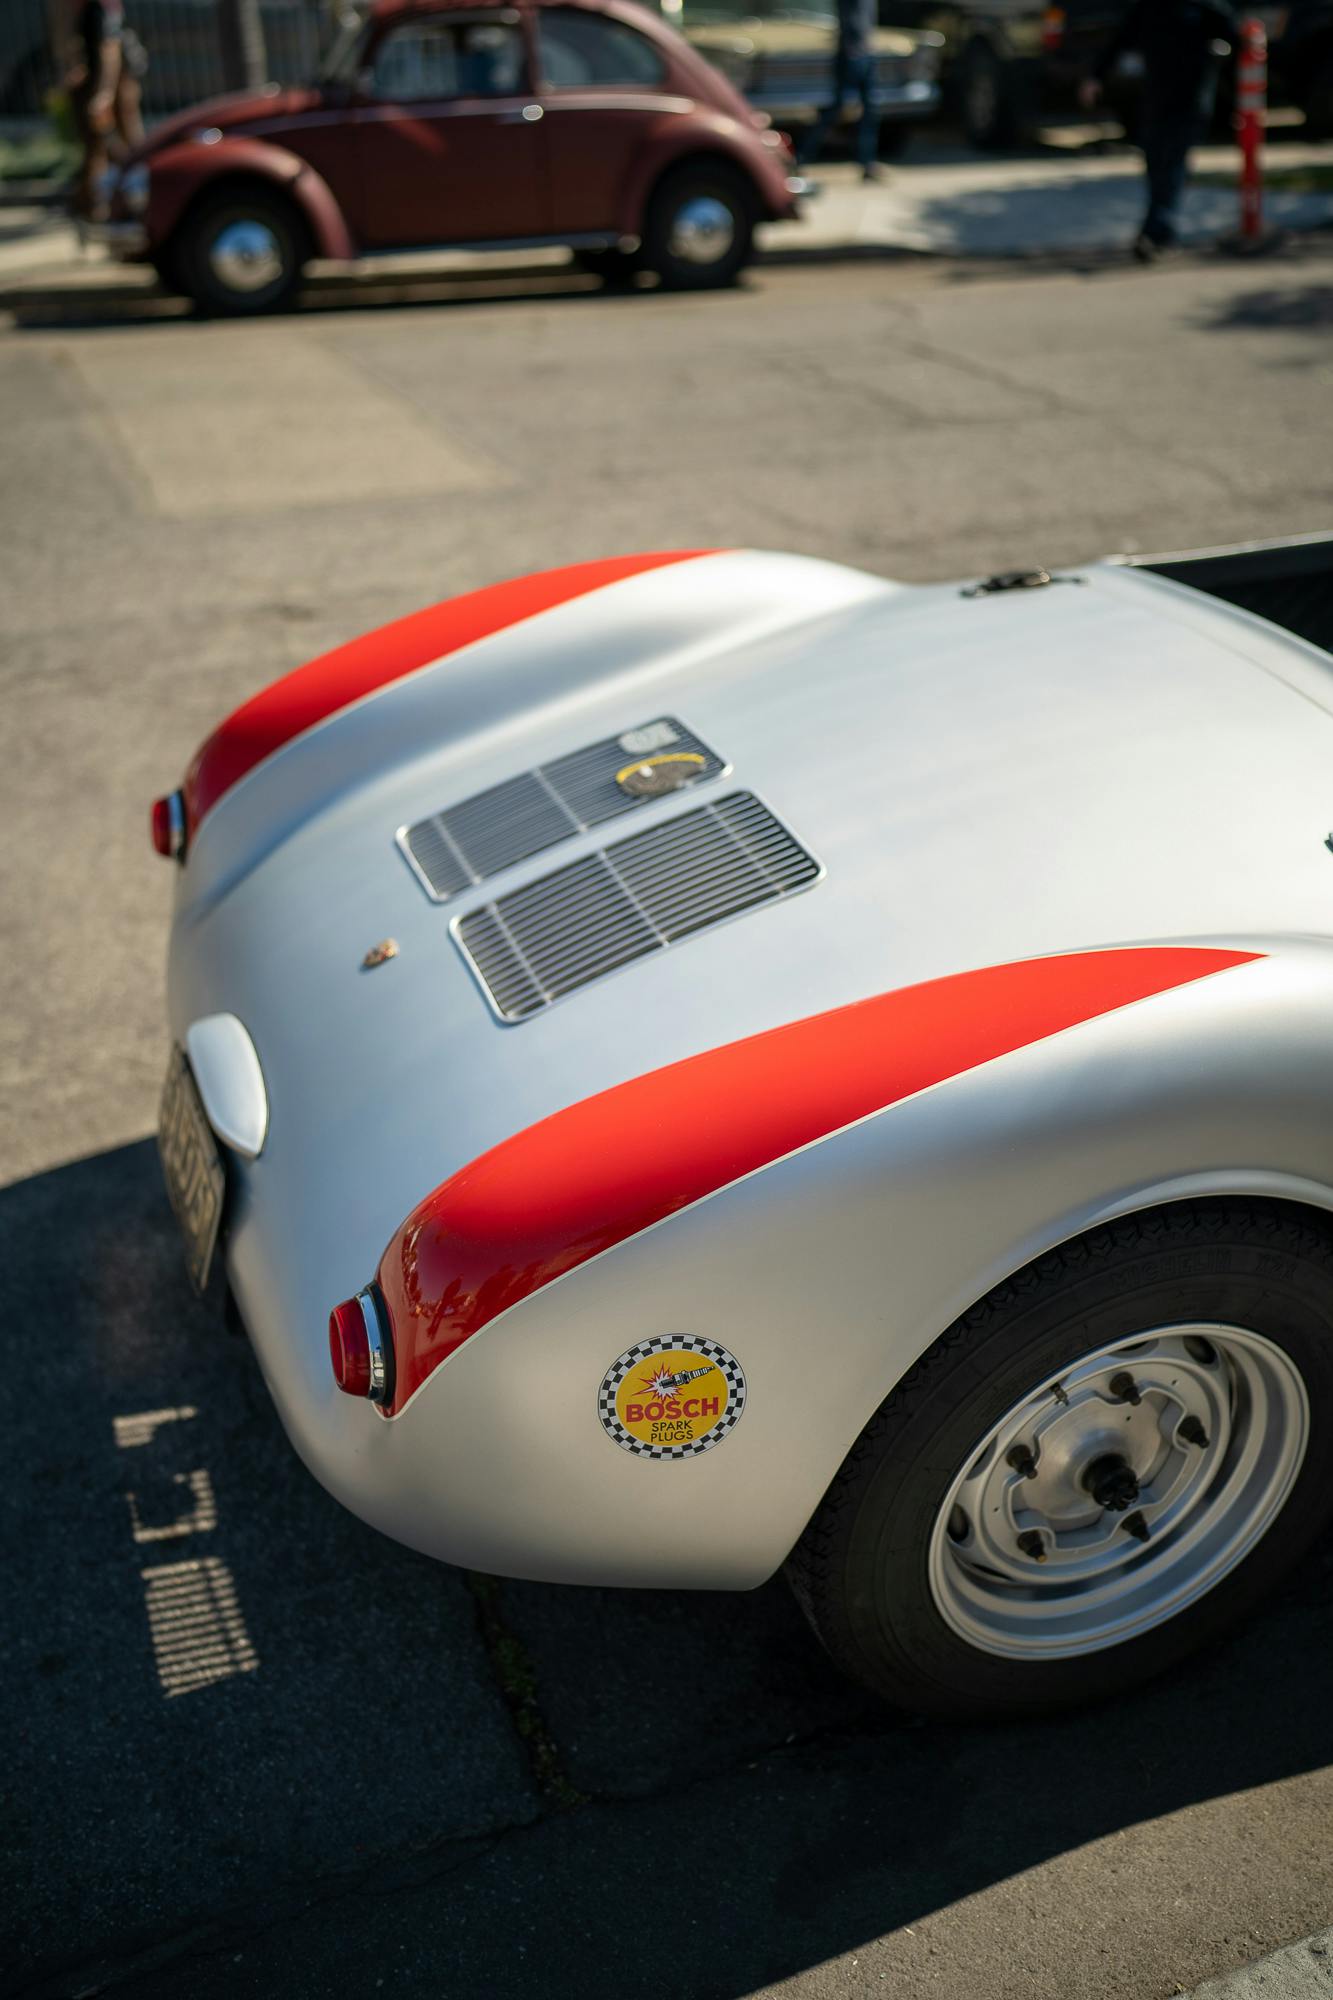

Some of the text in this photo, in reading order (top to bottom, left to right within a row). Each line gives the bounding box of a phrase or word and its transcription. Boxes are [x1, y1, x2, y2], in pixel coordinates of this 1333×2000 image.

[1111, 1247, 1232, 1290] MICHELIN
[626, 1397, 719, 1423] BOSCH
[652, 1420, 693, 1432] SPARK
[651, 1430, 693, 1442] PLUGS
